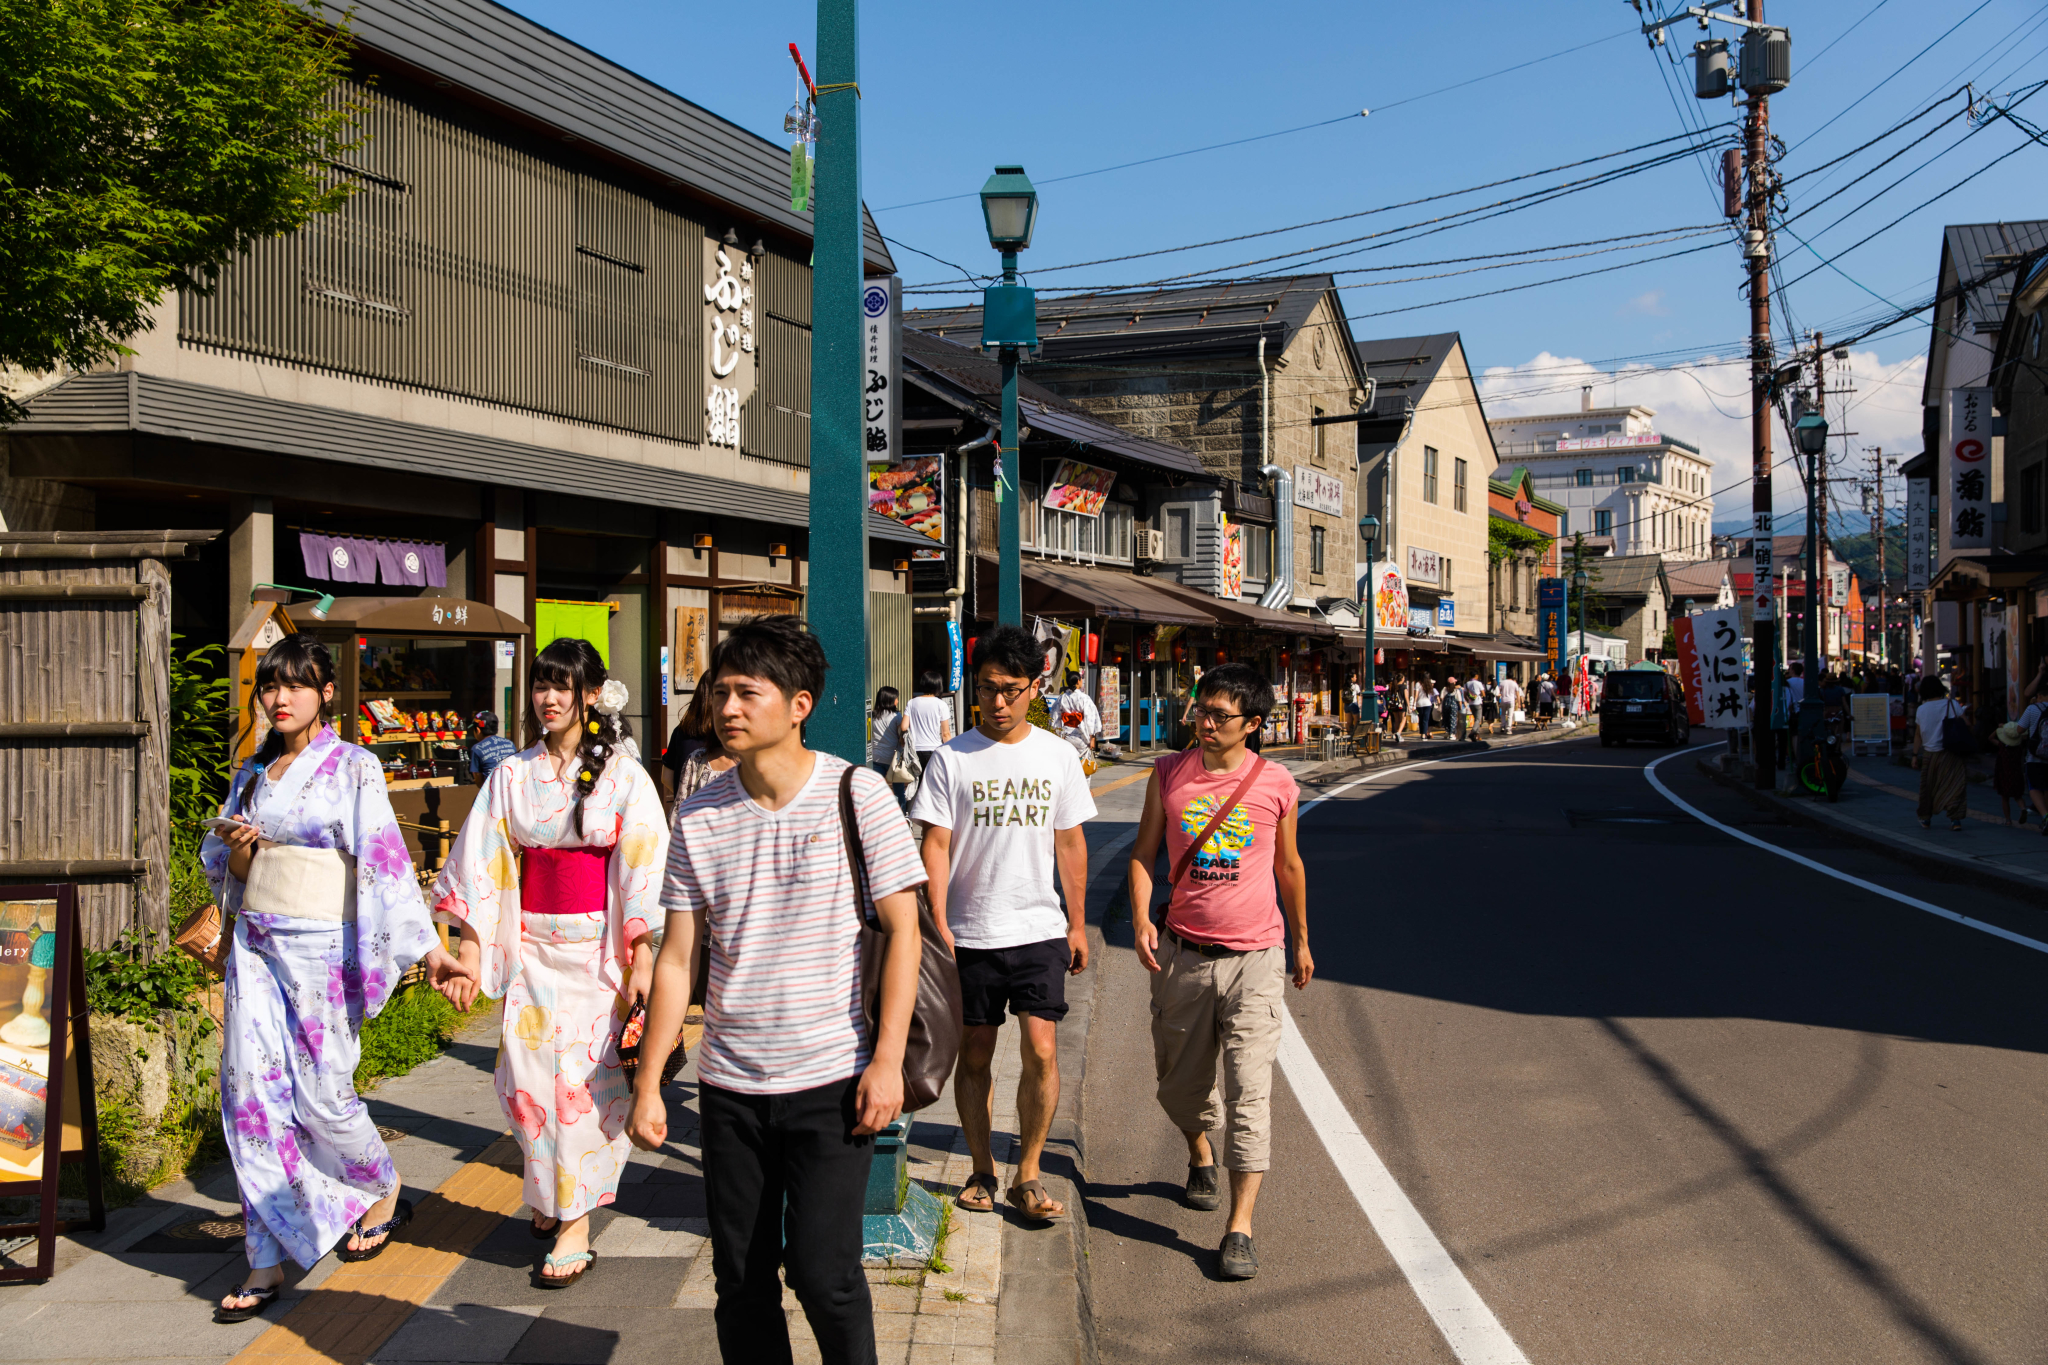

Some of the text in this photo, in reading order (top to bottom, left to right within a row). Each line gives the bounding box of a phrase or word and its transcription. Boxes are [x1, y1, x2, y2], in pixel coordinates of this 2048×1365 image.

[740, 260, 755, 353] 積丹料理
[704, 250, 743, 448] ふじ鮨
[869, 324, 879, 364] 積丹料理
[866, 369, 888, 453] ふじ鮨
[1964, 393, 1978, 433] おたる
[1954, 468, 1986, 539] 菊鮨
[1755, 515, 1771, 584] 北一硝子
[1912, 501, 1925, 576] 大正硝子館
[1713, 620, 1743, 719] うに丼
[972, 777, 1052, 803] BEAMS
[973, 804, 1050, 827] HEART
[1189, 869, 1240, 881] CRANE
[1191, 856, 1240, 869] SPACE
